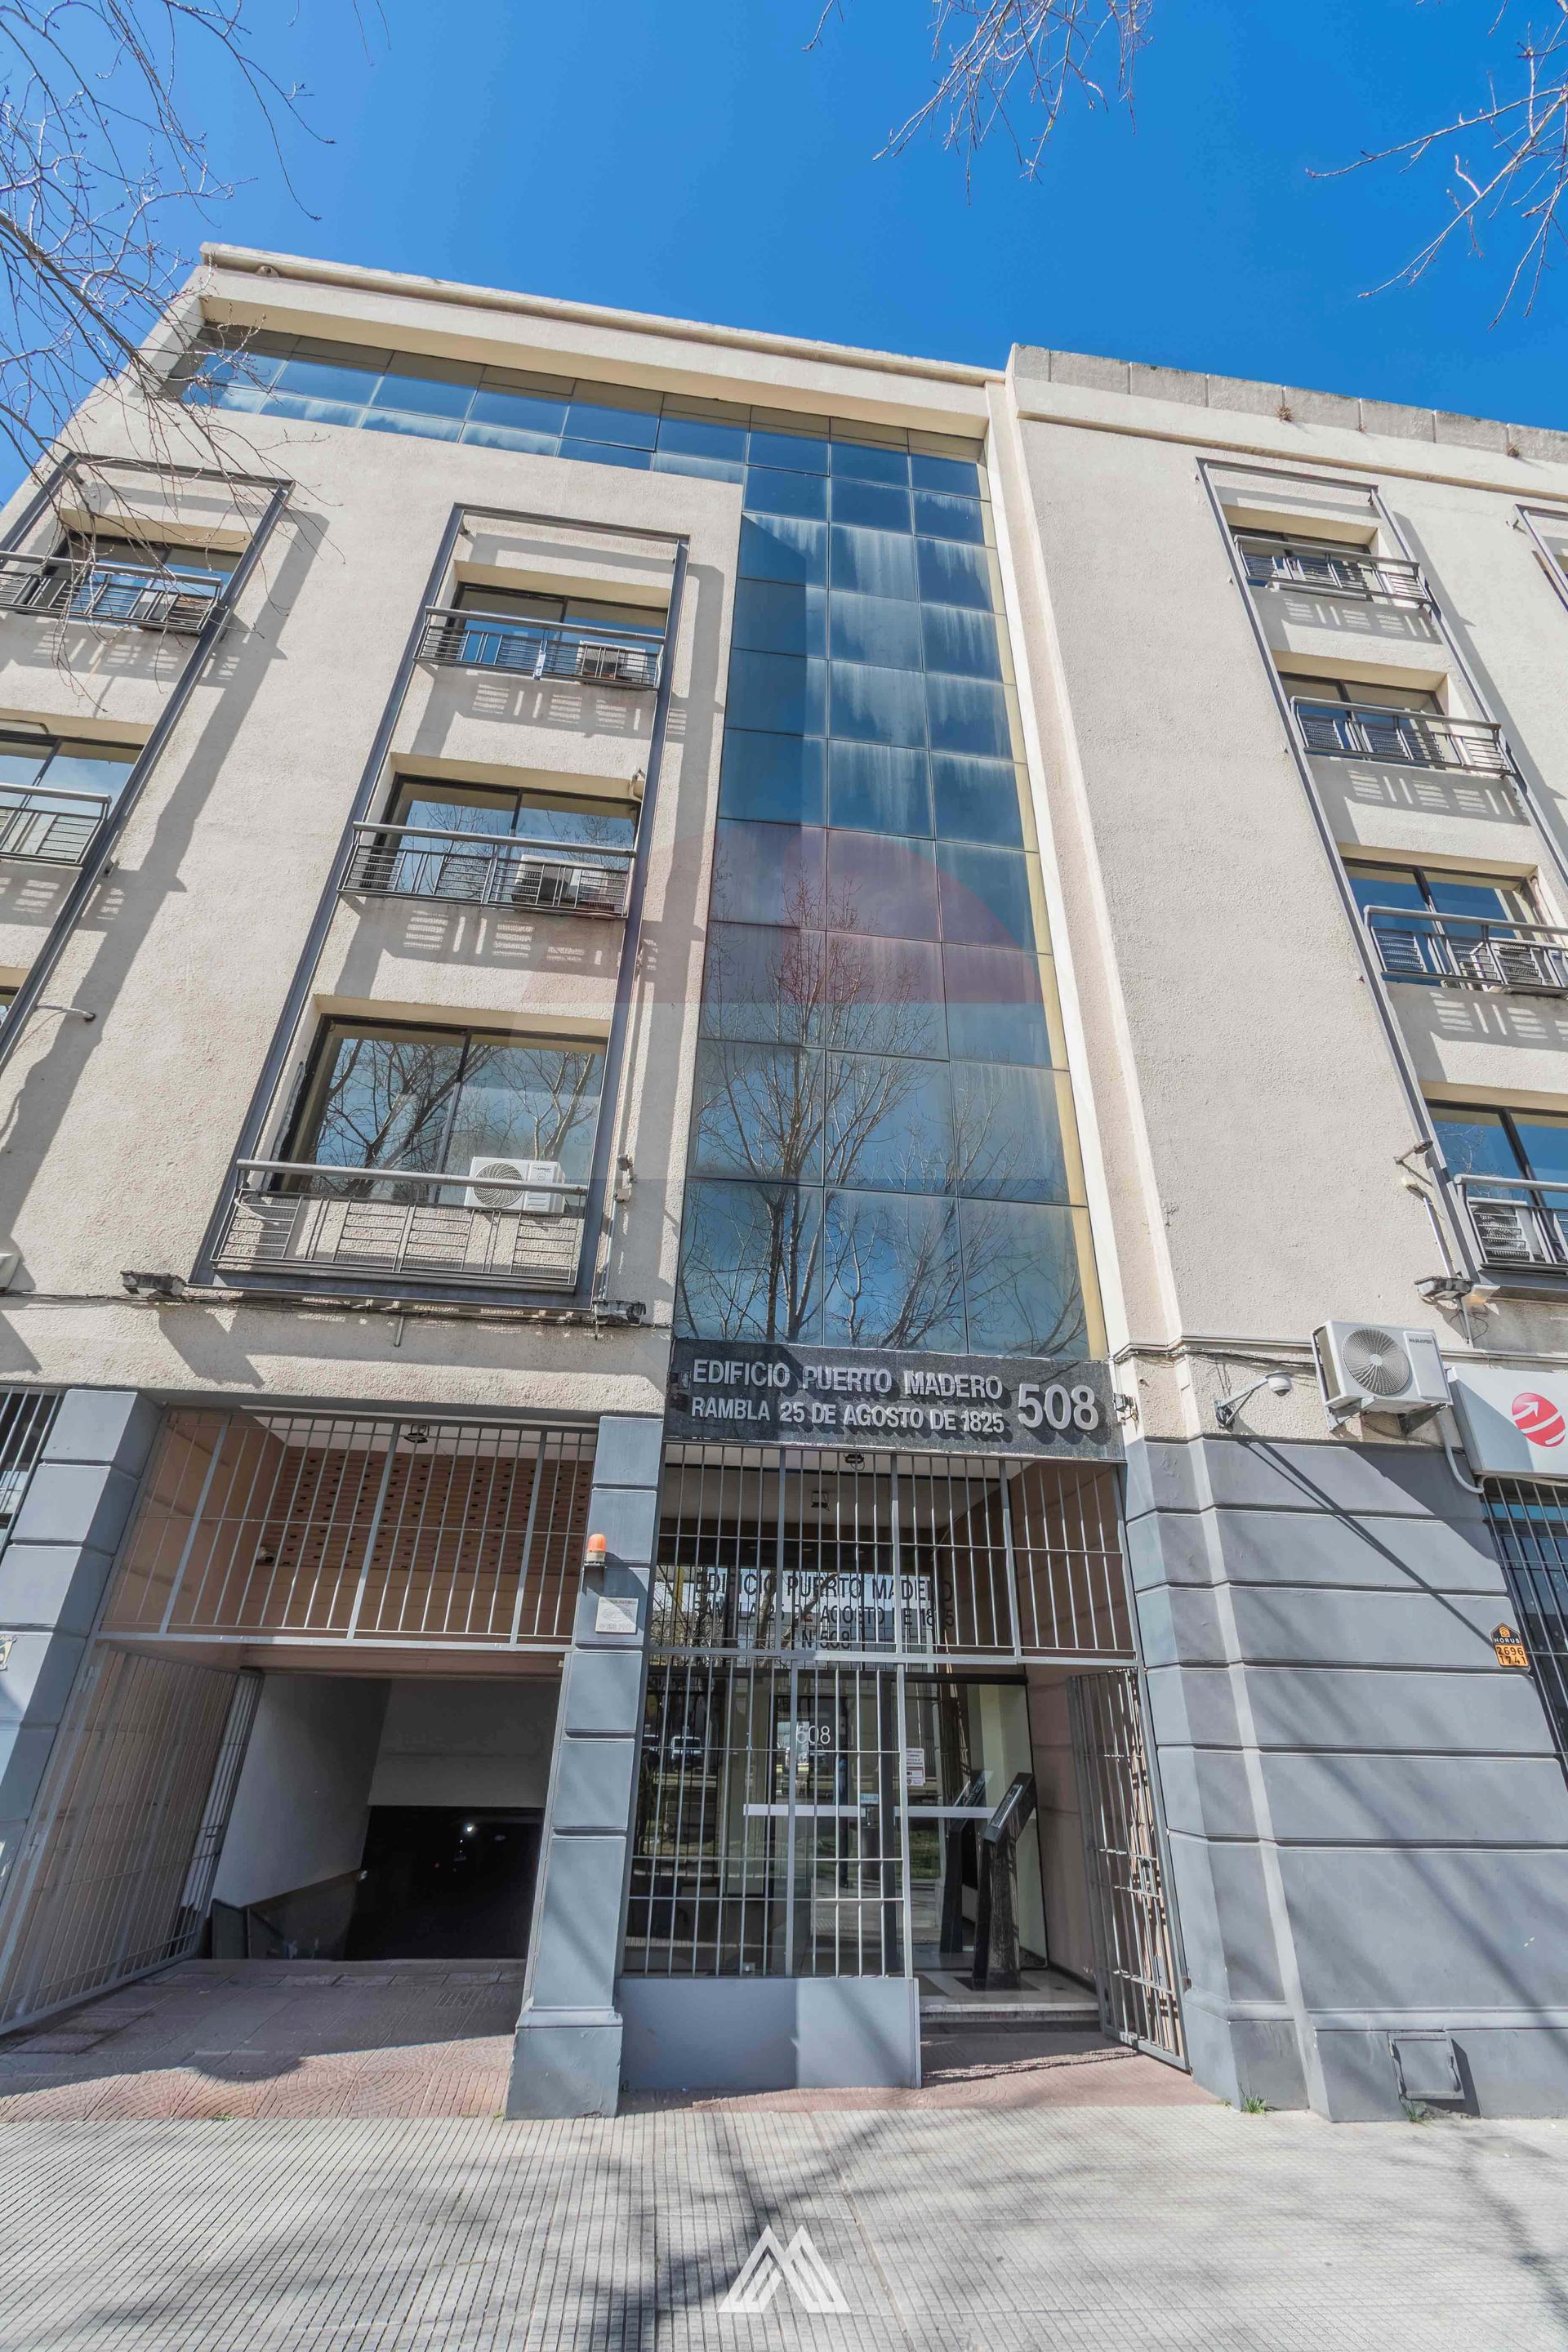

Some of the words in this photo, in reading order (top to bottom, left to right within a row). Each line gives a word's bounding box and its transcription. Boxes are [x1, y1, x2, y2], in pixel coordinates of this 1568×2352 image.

[693, 1359, 791, 1388] EDIFICIO
[802, 1365, 893, 1393] PUERTO
[903, 1370, 1004, 1400] MADERO
[691, 1396, 771, 1422] RAMBLA
[780, 1401, 805, 1423] 25
[811, 1402, 836, 1425] DE
[843, 1403, 924, 1429] AGOSTO
[929, 1408, 957, 1431] DE
[960, 1410, 1005, 1433] 1825
[1018, 1383, 1099, 1431] 508
[1496, 1646, 1524, 1656] 2696
[1499, 1655, 1526, 1665] 1741
